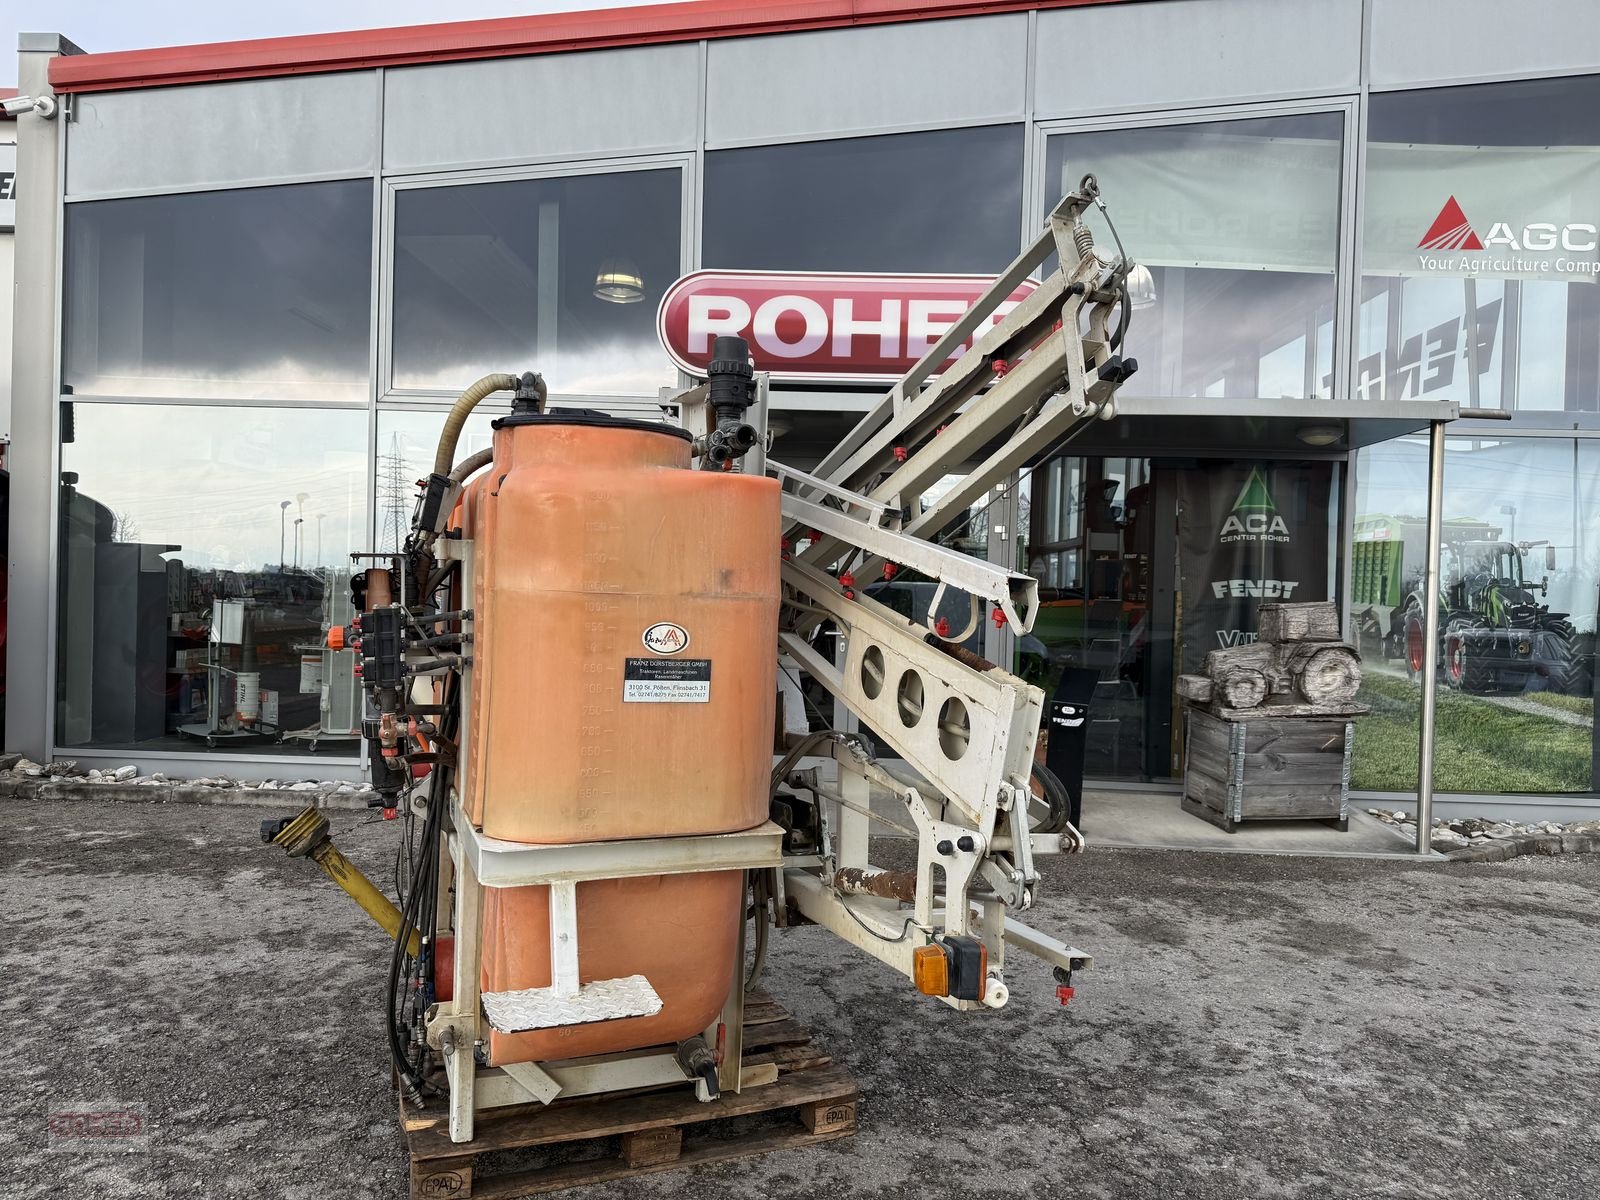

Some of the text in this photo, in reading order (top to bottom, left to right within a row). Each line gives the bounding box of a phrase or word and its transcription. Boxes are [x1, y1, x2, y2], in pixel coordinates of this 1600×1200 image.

[1419, 255, 1455, 270] Your
[1459, 255, 1549, 274] Agriculture
[1220, 514, 1289, 535] ACA
[1211, 580, 1299, 599] FENDT
[425, 1176, 458, 1193] EPAL
